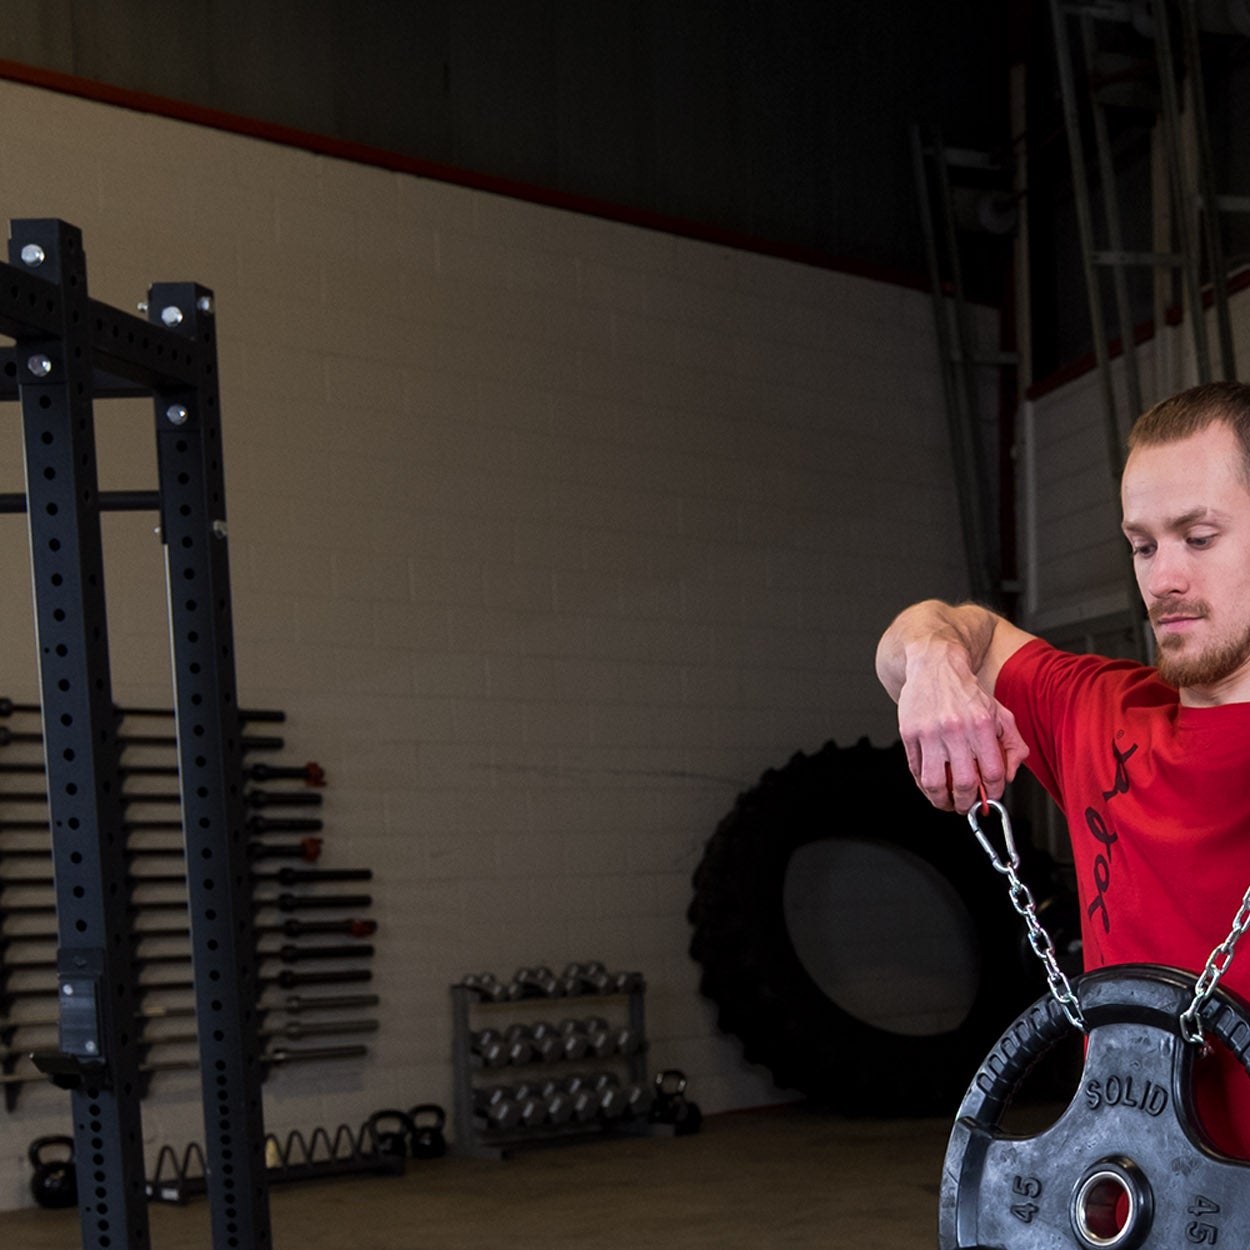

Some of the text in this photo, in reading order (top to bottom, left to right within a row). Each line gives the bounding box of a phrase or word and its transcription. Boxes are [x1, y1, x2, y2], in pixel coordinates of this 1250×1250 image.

[1086, 1075, 1168, 1116] SOLID
[1011, 1176, 1041, 1223] 45
[1188, 1195, 1220, 1245] 45
